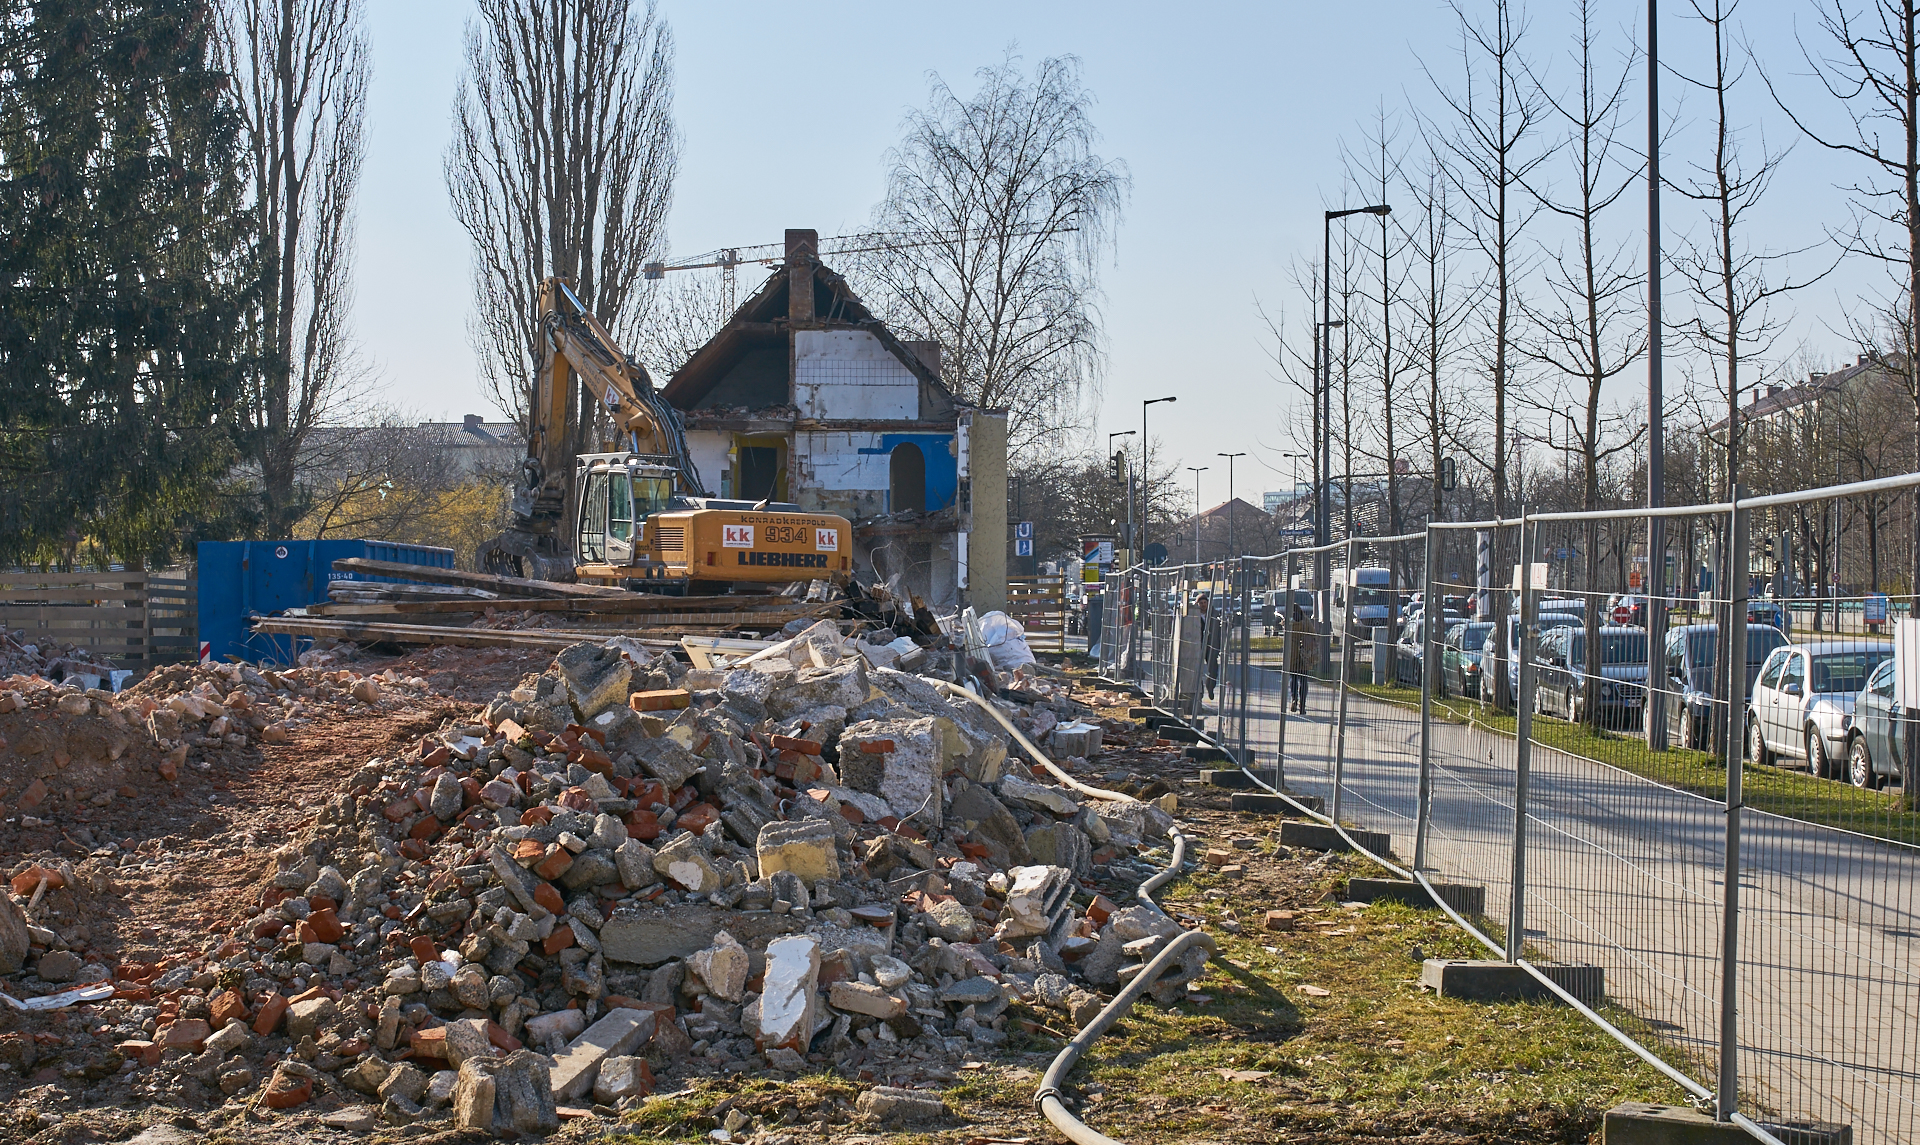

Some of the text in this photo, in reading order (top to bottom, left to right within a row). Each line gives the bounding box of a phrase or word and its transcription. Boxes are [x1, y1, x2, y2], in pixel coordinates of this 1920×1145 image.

[765, 526, 807, 544] 934
[1018, 523, 1030, 537] U
[738, 551, 828, 568] LIEBHERR
